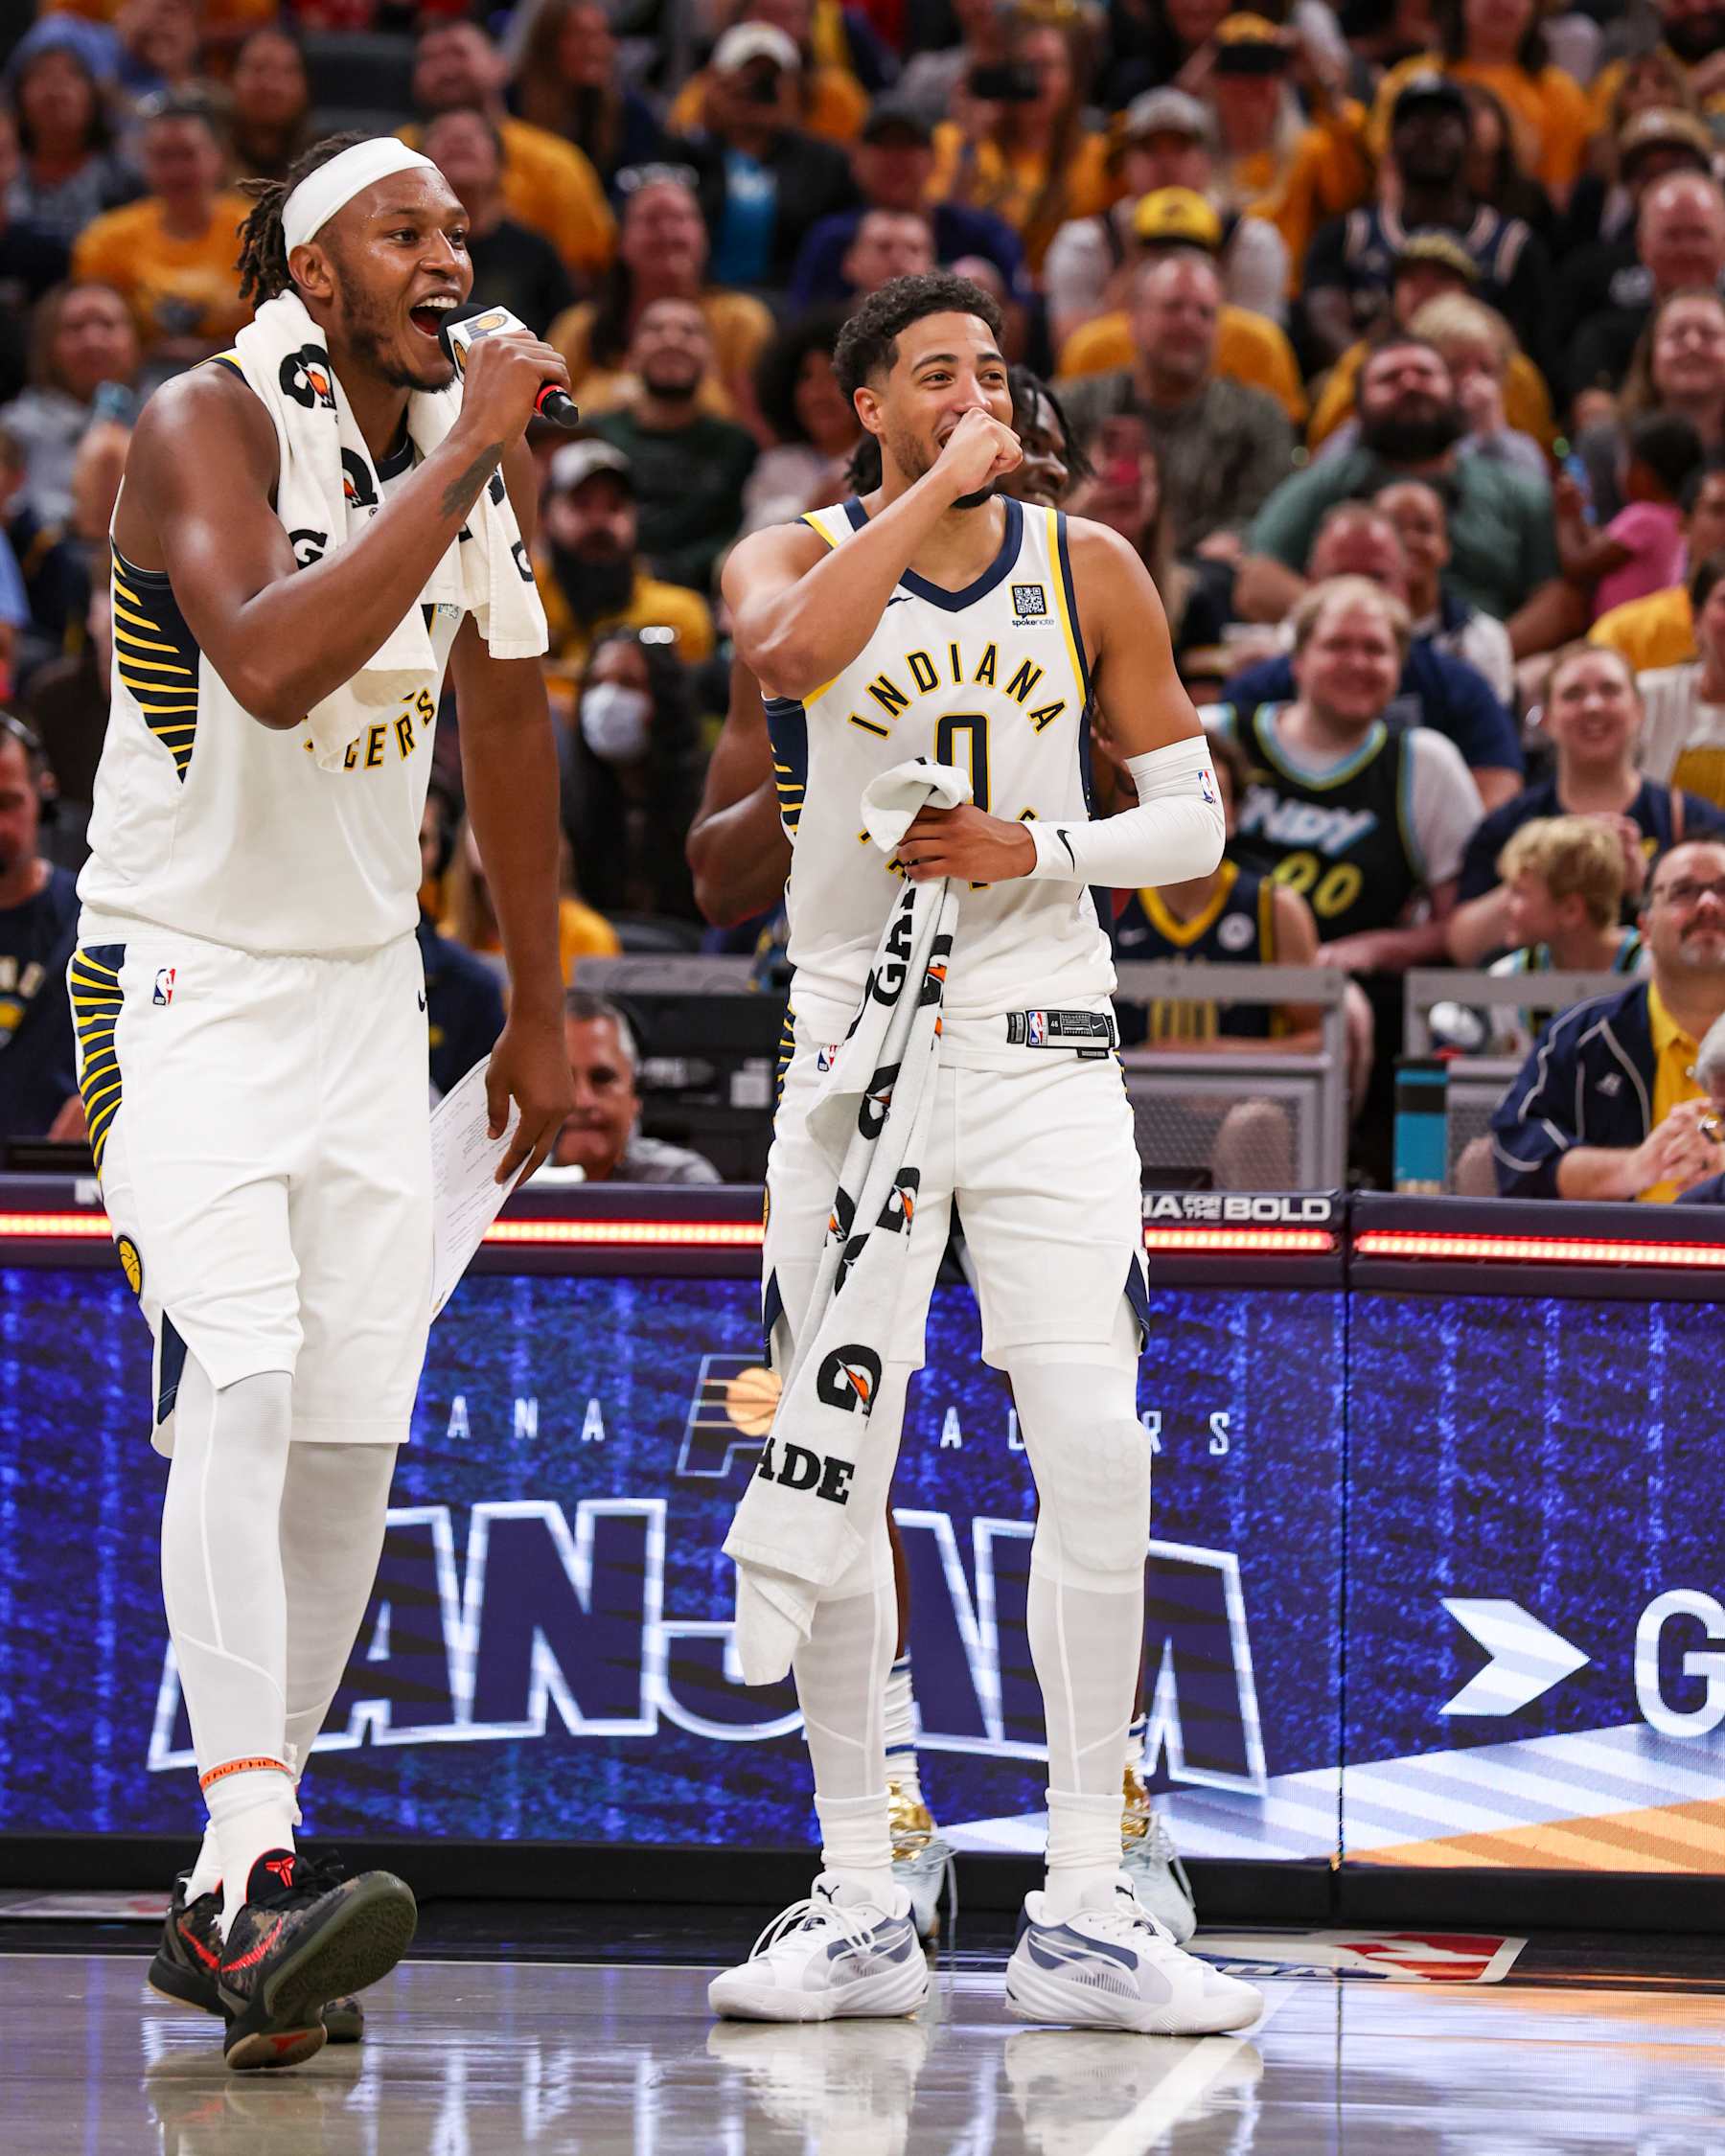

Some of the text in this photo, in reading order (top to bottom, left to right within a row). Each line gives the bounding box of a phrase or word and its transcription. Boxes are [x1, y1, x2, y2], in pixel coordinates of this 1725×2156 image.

[1012, 619, 1055, 628] spokenote
[848, 641, 1068, 741] INDIANA
[1224, 1197, 1331, 1222] BOLD
